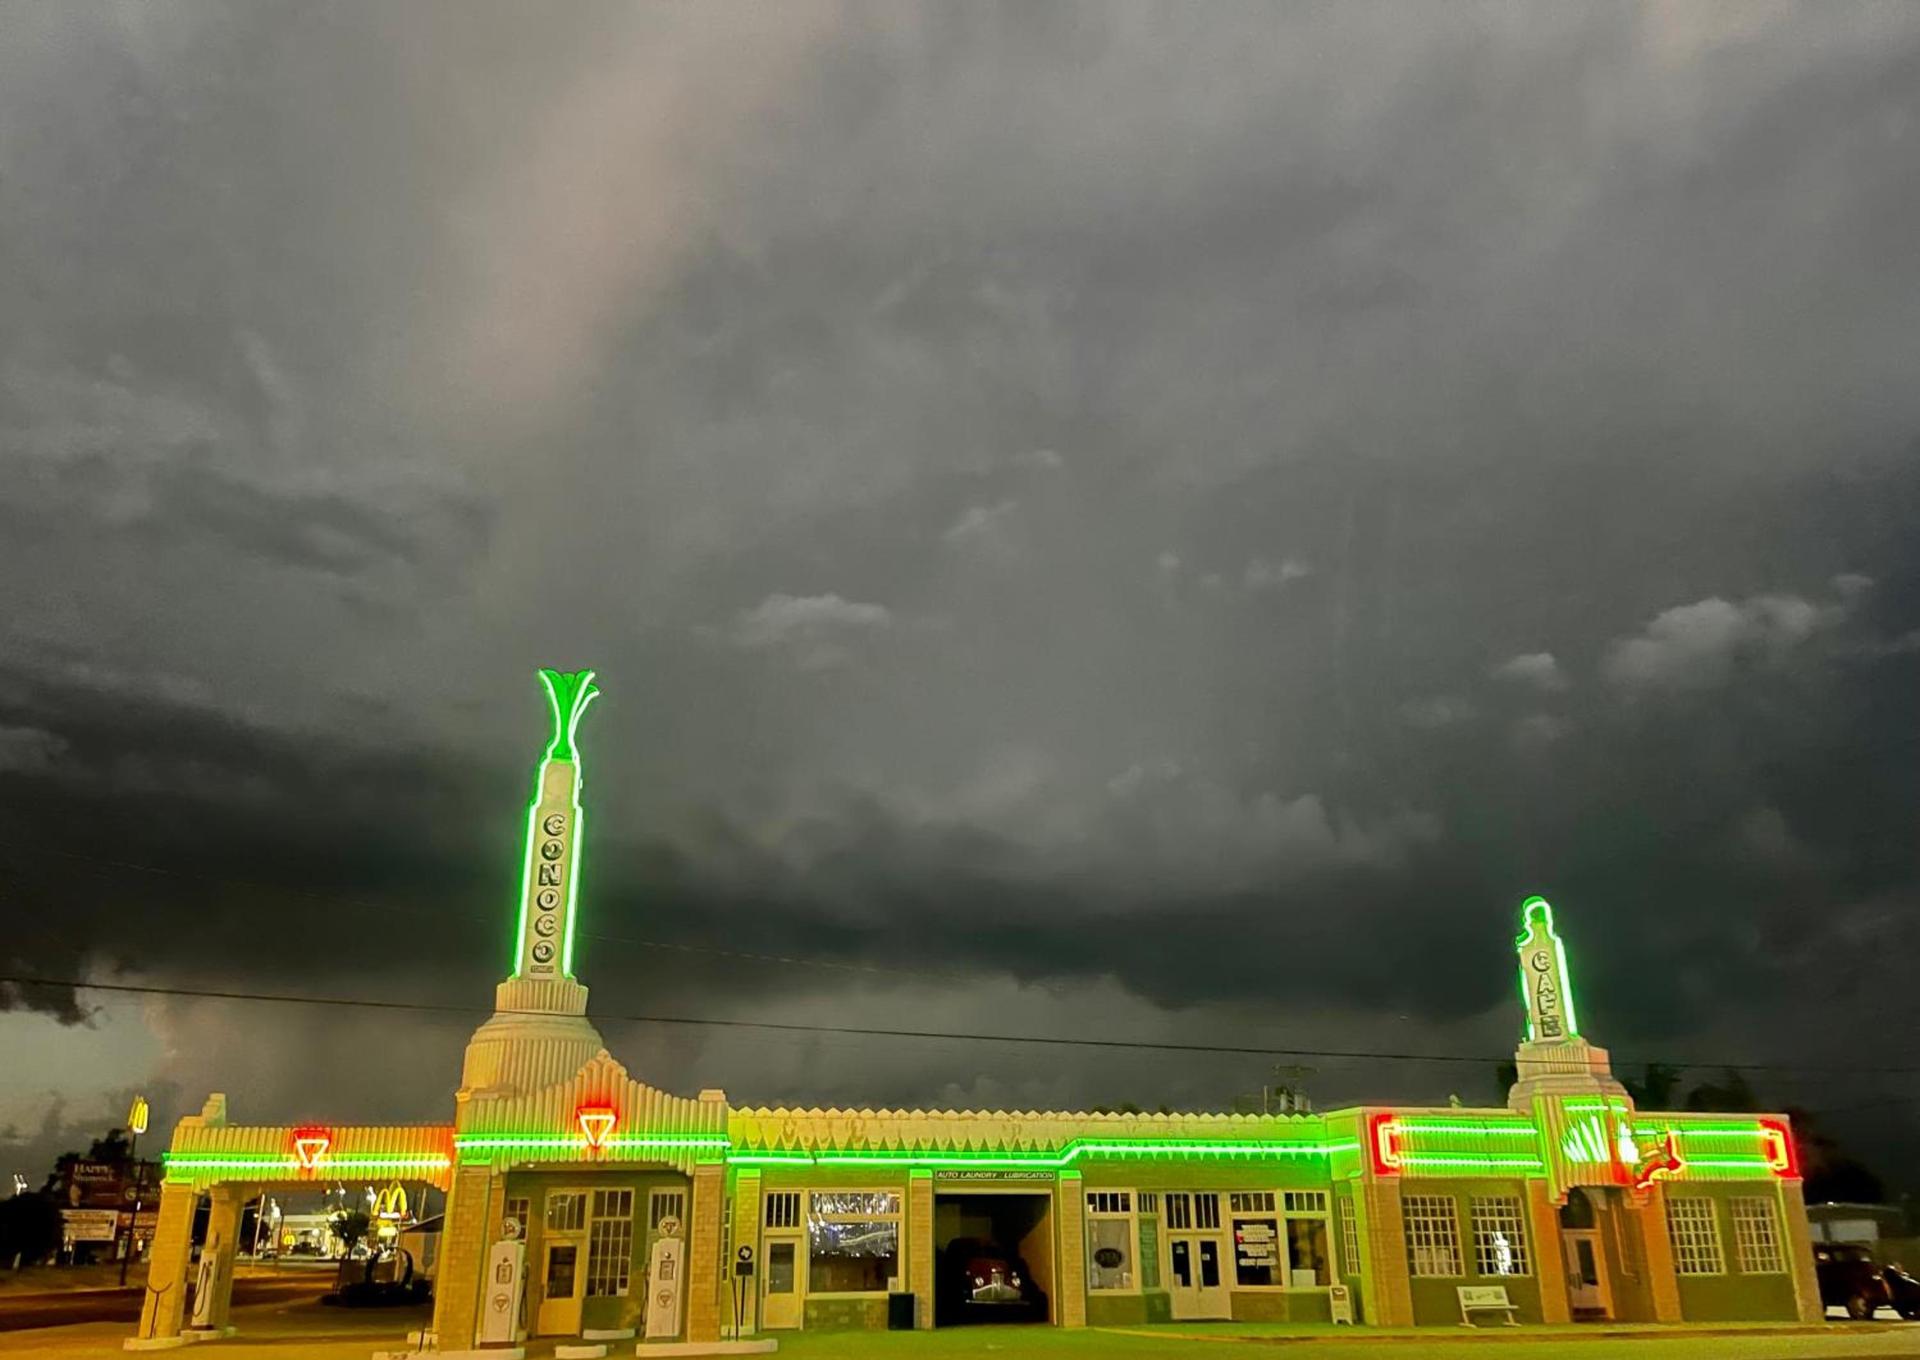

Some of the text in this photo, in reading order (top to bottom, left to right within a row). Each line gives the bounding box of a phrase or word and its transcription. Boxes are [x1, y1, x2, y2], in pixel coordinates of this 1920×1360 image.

[532, 813, 566, 963] CONOCO
[1532, 950, 1562, 1037] CAFE
[938, 1171, 959, 1179] AUTO
[960, 1171, 997, 1179] LAUNDRY
